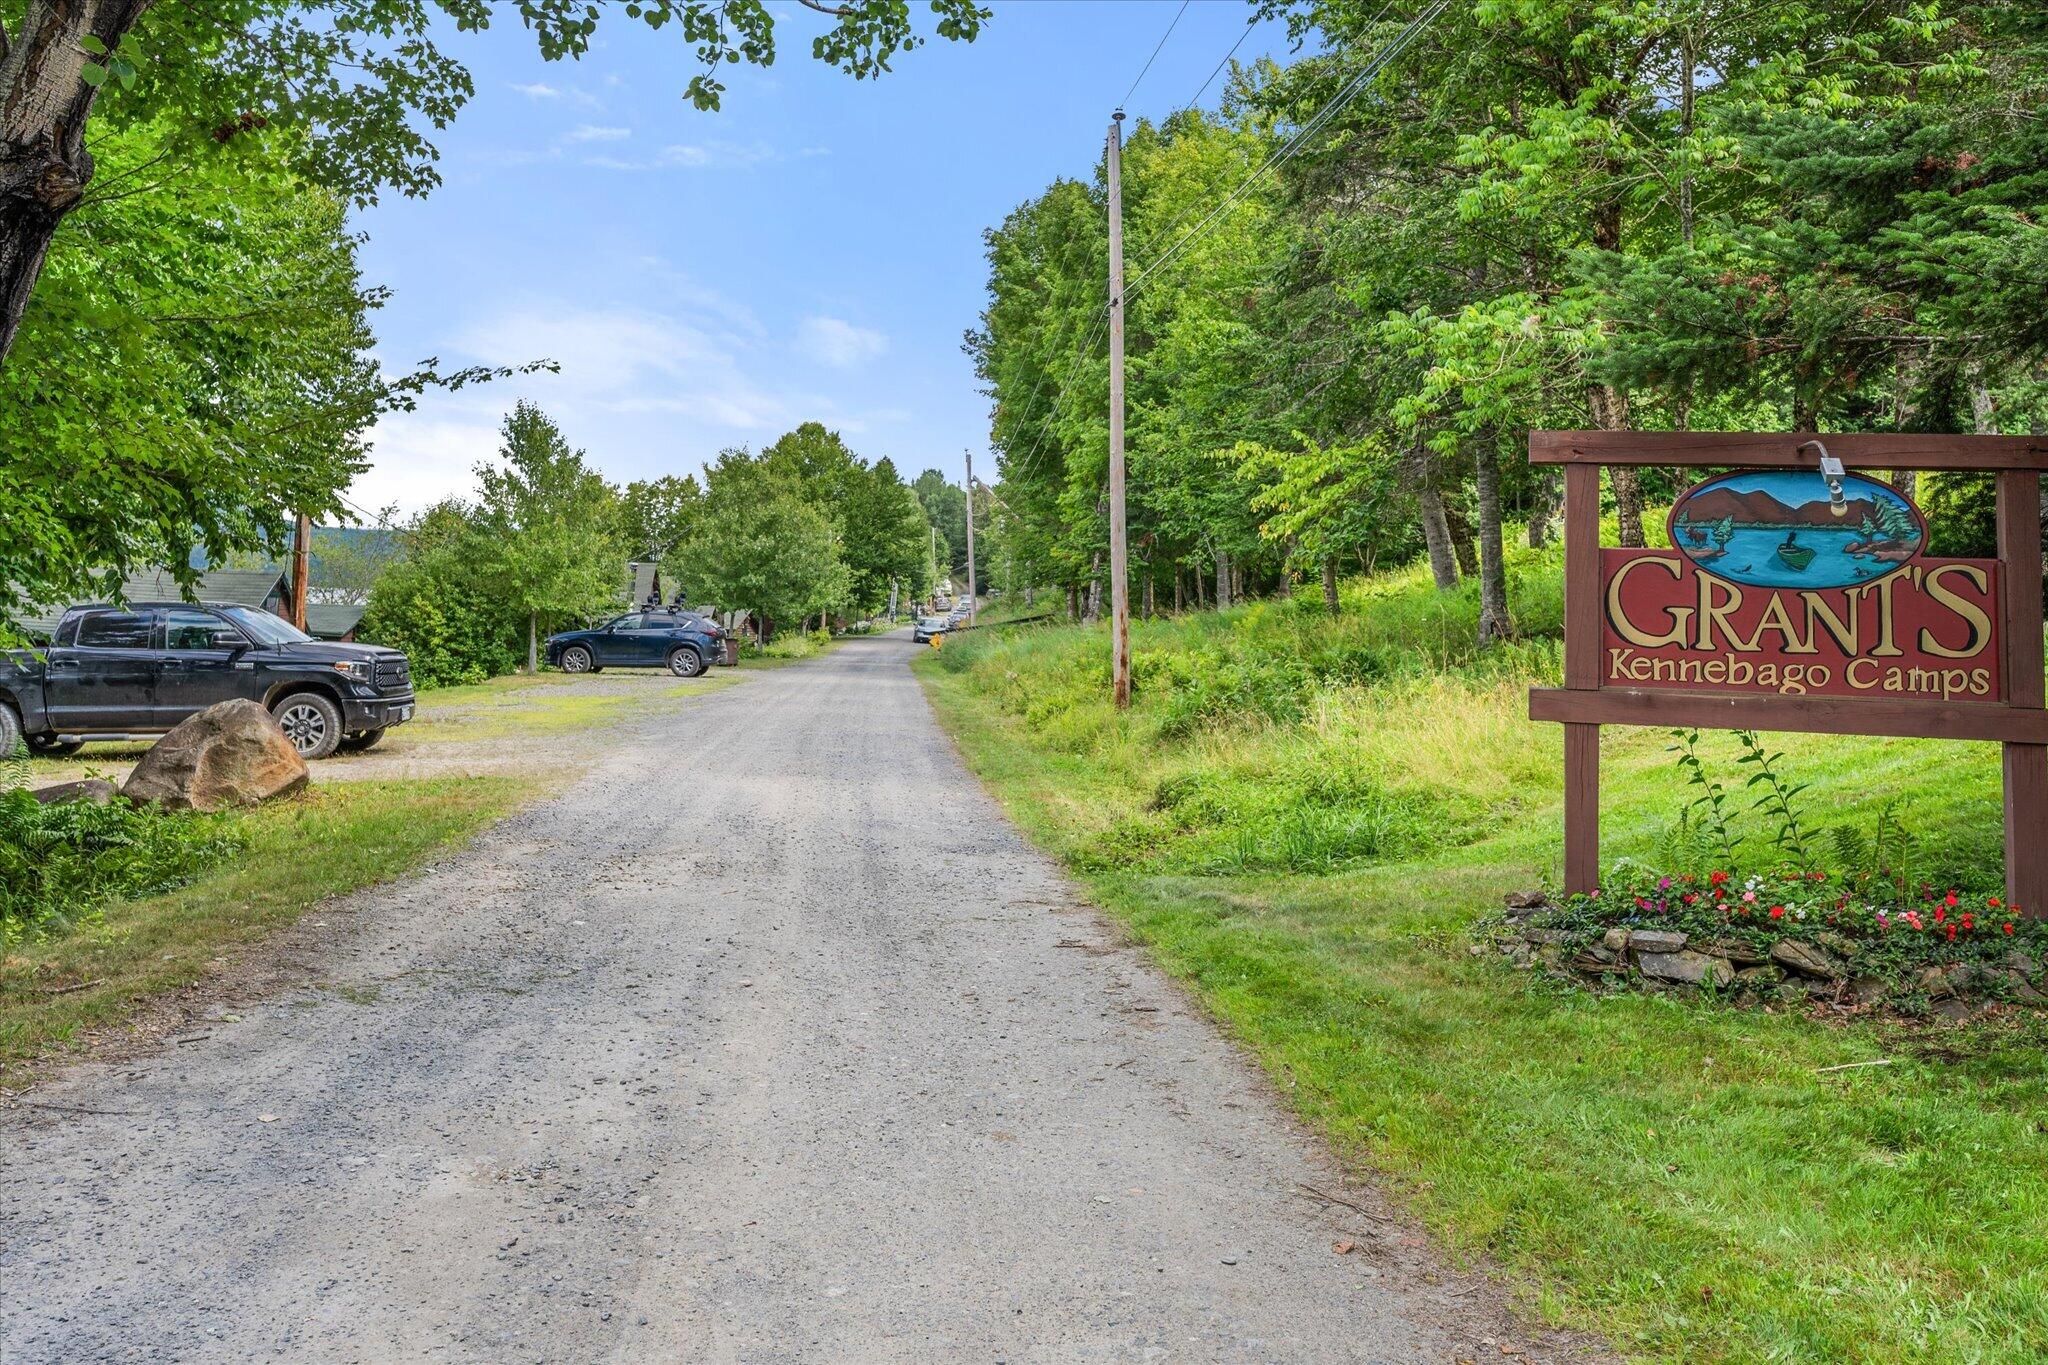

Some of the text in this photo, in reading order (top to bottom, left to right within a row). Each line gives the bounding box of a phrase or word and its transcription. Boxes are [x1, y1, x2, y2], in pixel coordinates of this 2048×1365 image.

[1605, 556, 1992, 658] GRANT'S
[1608, 648, 1991, 701] Kennebago Camps
